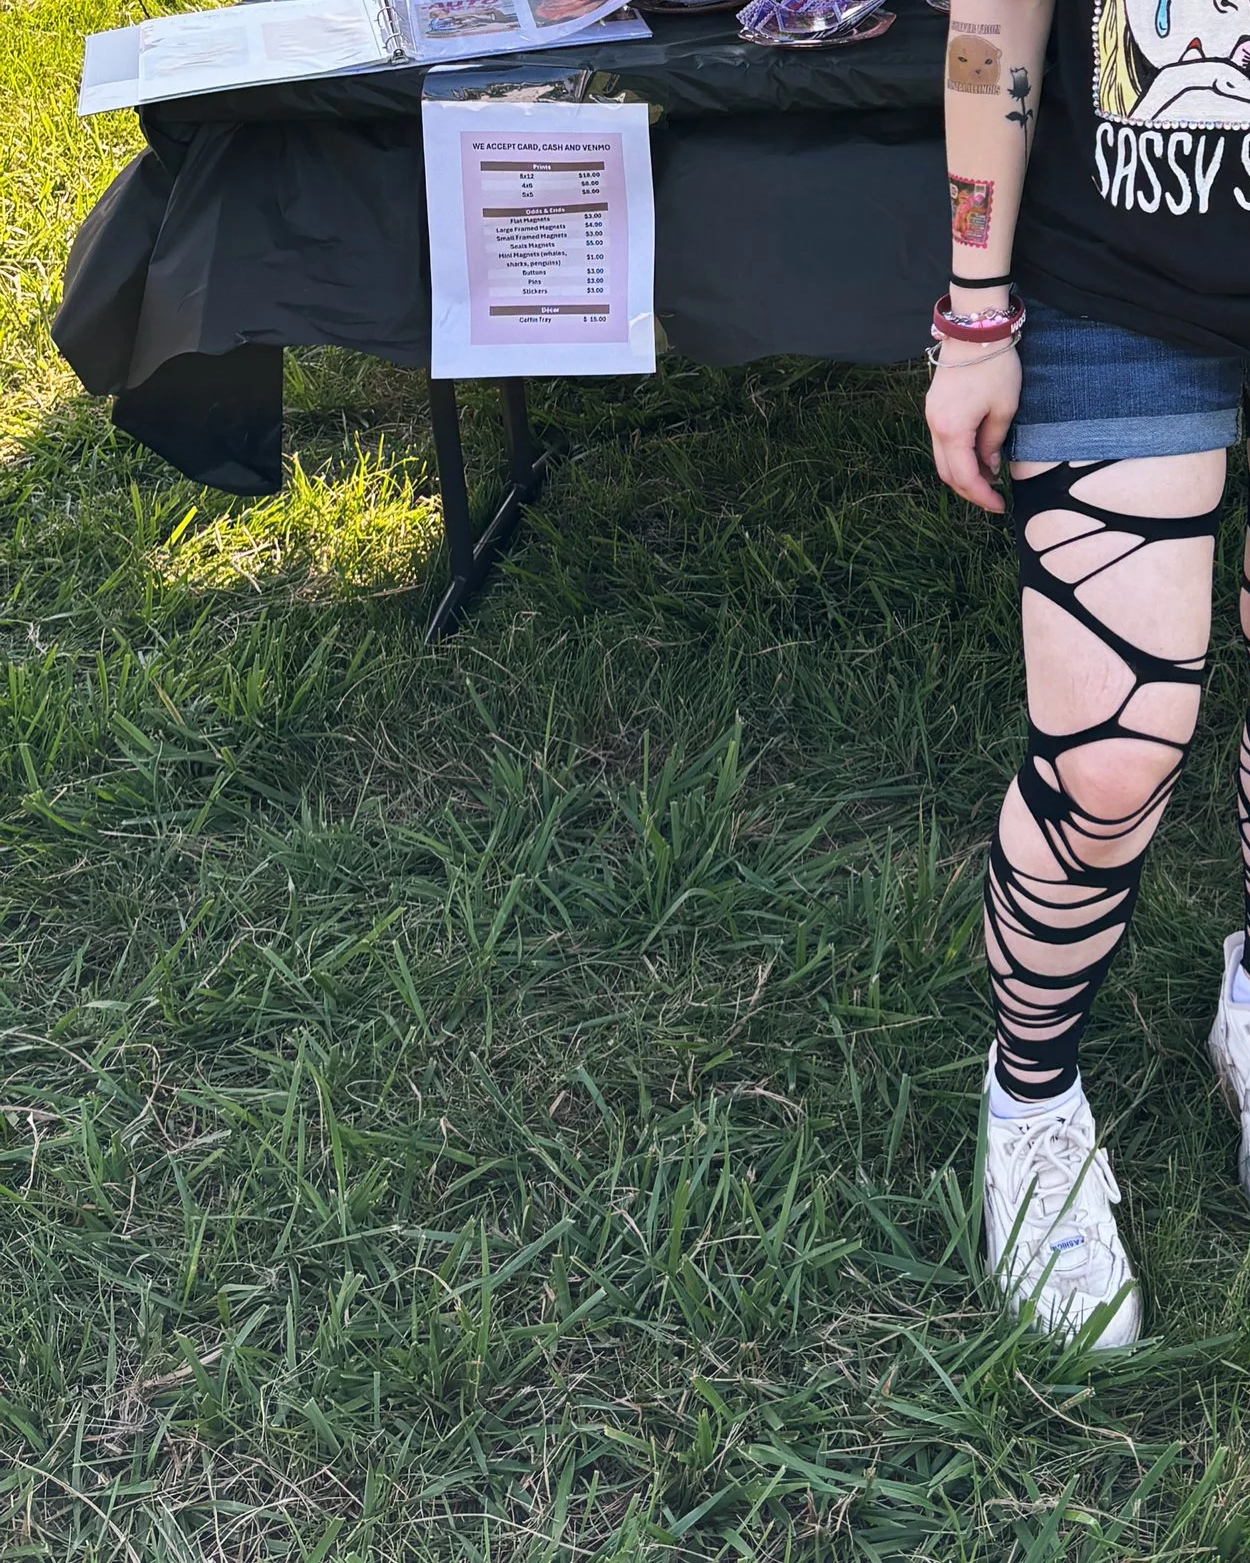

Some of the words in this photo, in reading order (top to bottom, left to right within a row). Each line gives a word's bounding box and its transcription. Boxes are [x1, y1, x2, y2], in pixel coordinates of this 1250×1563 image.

[486, 143, 516, 151] ACCEPT
[517, 143, 541, 151] CARD,
[542, 143, 563, 151] CASH
[1094, 122, 1225, 216] SASSY
[541, 232, 567, 240] Magnets
[528, 241, 555, 249] Magnets
